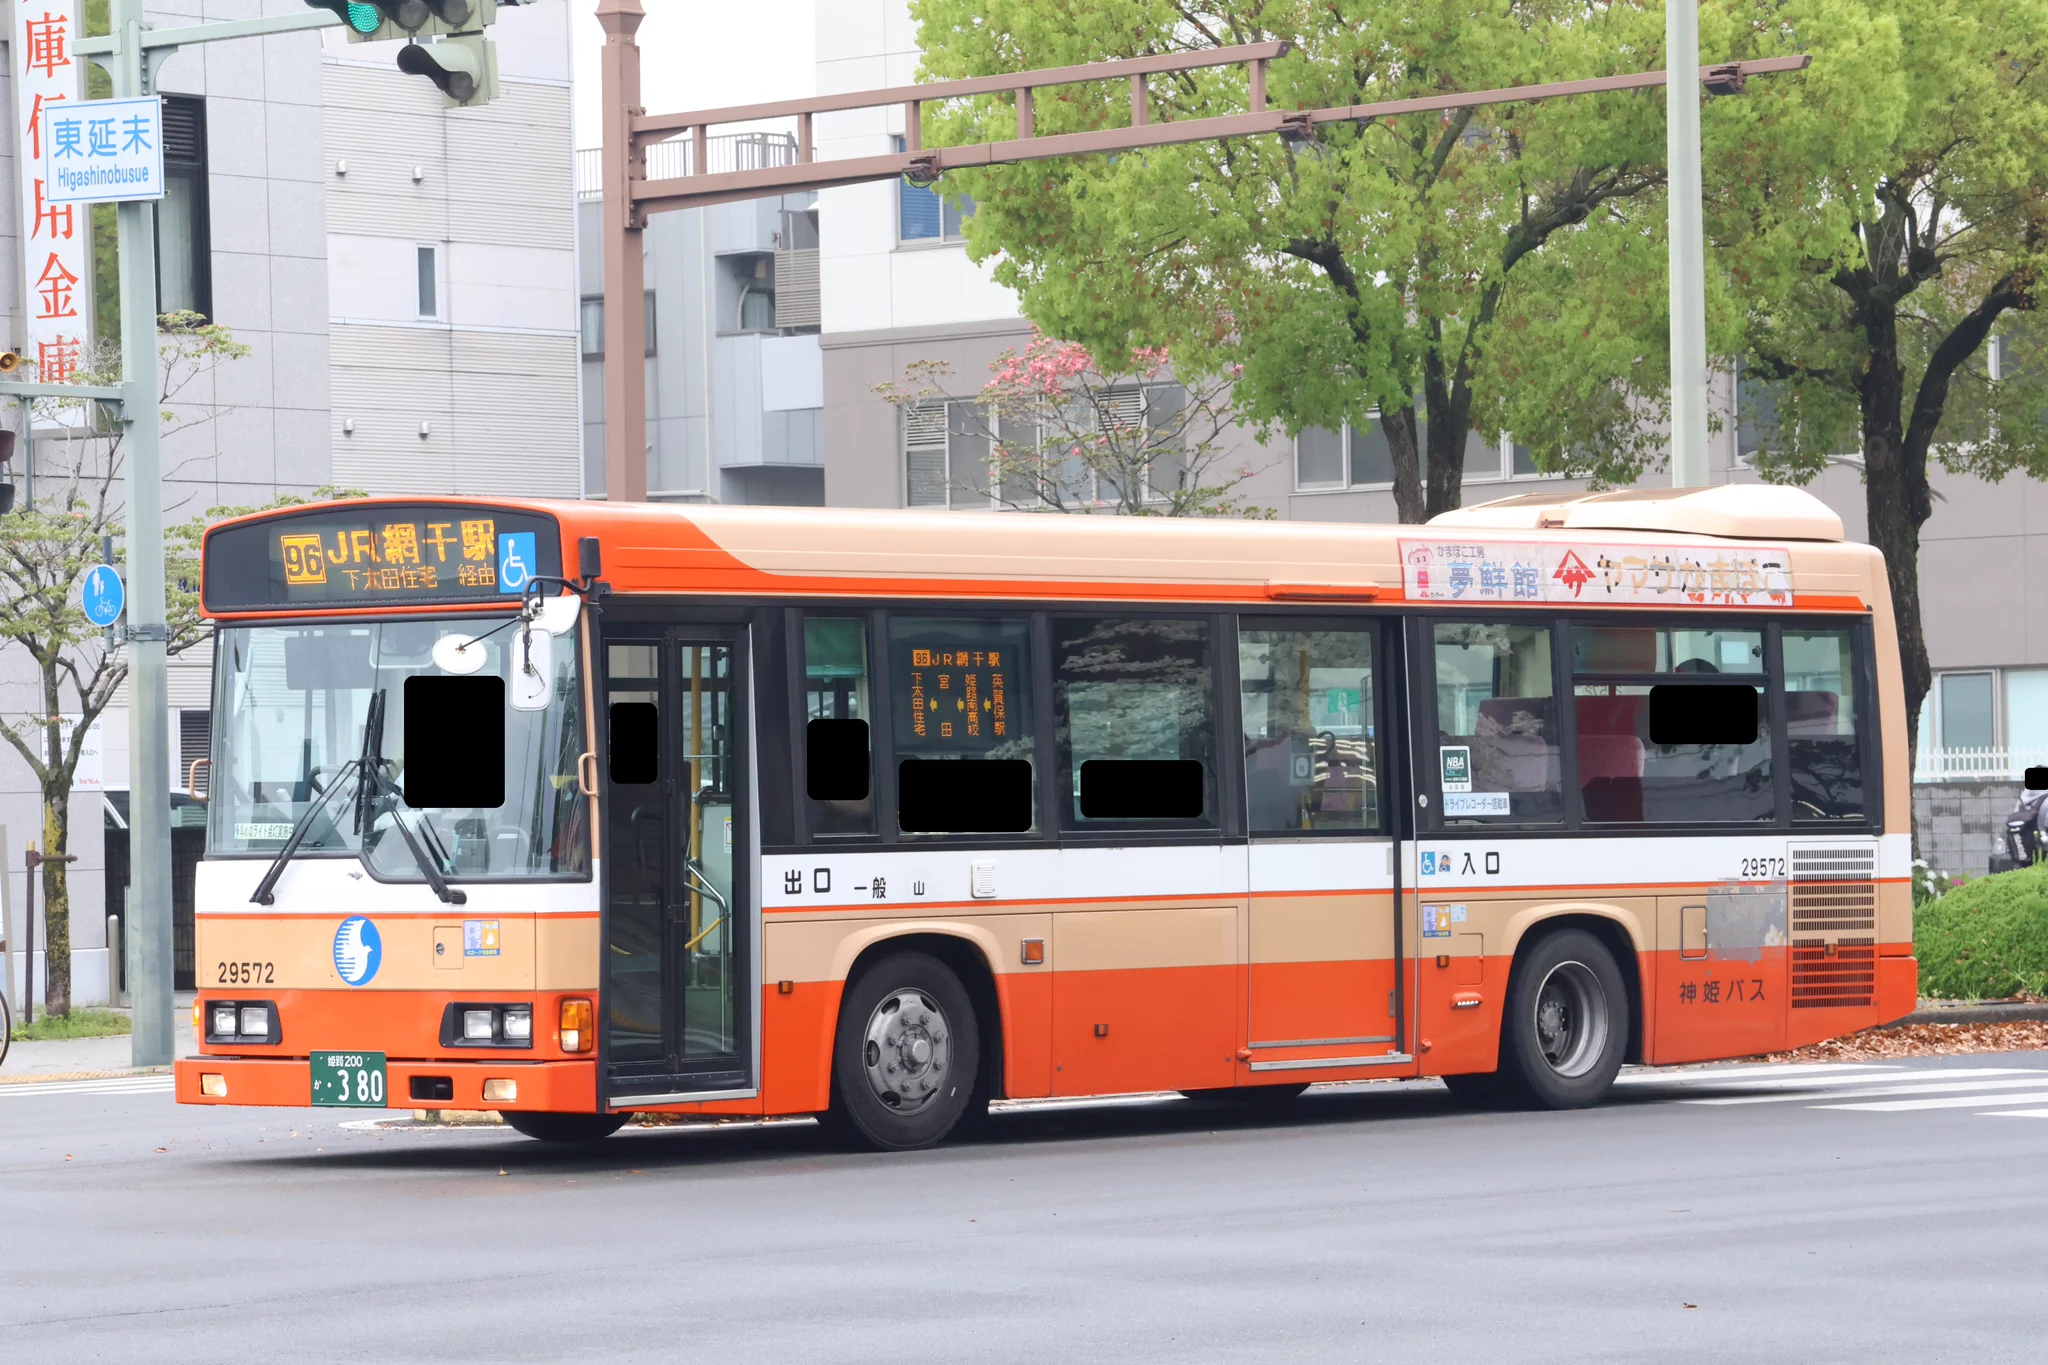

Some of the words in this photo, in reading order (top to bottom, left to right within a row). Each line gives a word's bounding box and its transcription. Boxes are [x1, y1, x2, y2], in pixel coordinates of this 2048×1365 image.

[53, 115, 153, 160] 東延末
[57, 164, 149, 192] Higashinobusue
[22, 0, 79, 384] 庫用金庫
[285, 541, 324, 578] 96
[327, 519, 496, 564] JR網干駅
[342, 565, 438, 591] 下太田住宅
[457, 563, 496, 586] 経由
[1447, 561, 1538, 599] 夢鮮館
[914, 651, 930, 666] 96
[931, 651, 1000, 667] JR網干駅
[938, 673, 952, 737] 宮田
[1446, 756, 1465, 768] NBA
[1461, 851, 1500, 876] 入口
[1741, 858, 1786, 877] 29572
[784, 867, 832, 895] 出口
[853, 877, 887, 899] 一般
[913, 880, 925, 896] 山
[218, 962, 275, 984] 29572
[1679, 979, 1765, 1004] 神姫バス
[327, 1055, 363, 1067] 姫路200
[313, 1079, 322, 1090] か
